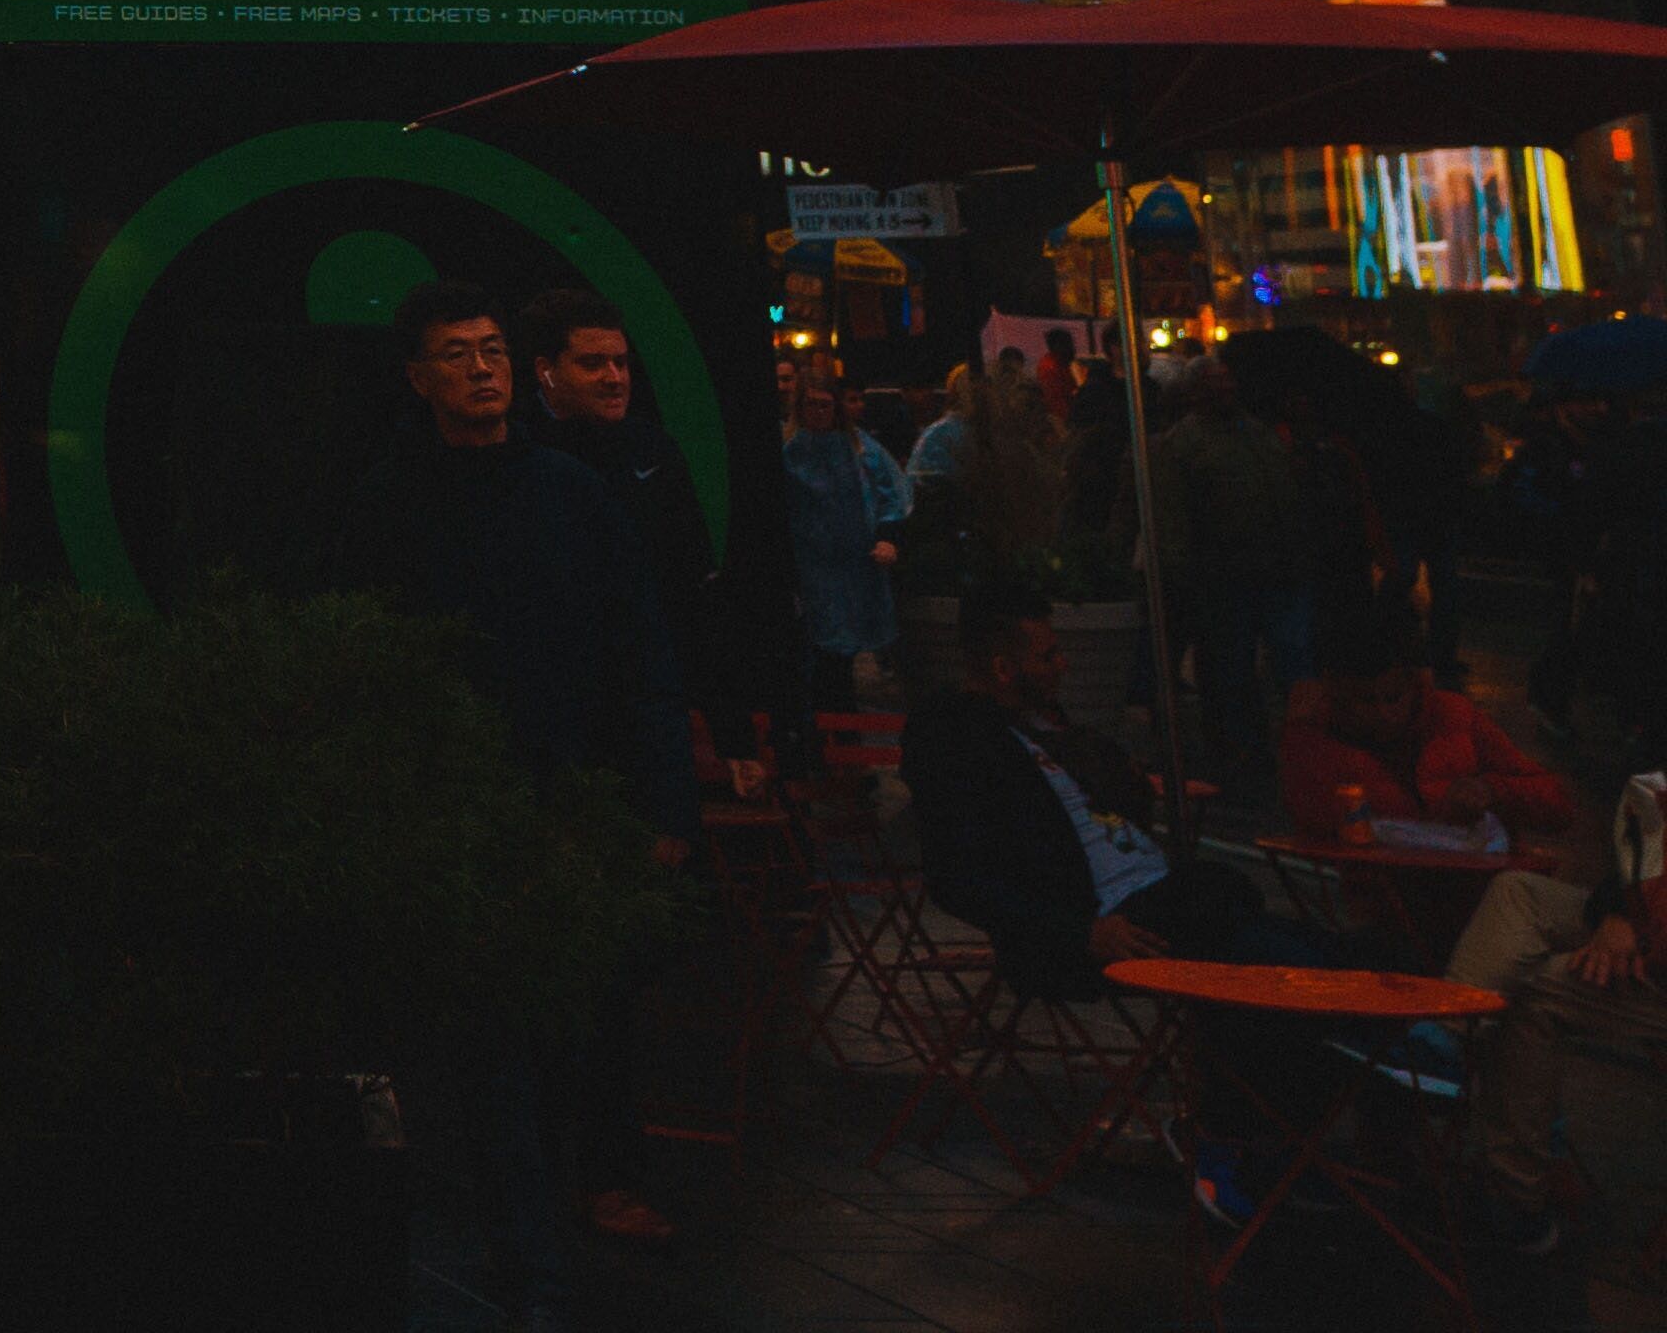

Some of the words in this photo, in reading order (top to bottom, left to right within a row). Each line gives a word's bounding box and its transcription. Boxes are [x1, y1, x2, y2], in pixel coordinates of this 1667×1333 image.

[54, 5, 113, 21] FREE
[120, 5, 208, 22] GUIDES
[233, 5, 294, 22] FREE
[298, 6, 362, 22] MAPS
[388, 6, 491, 23] TICKETS
[516, 7, 685, 25] INFORMATION
[794, 192, 869, 209] PEDESTRIAN
[797, 214, 823, 230] KEEP
[827, 213, 871, 230] MOVING
